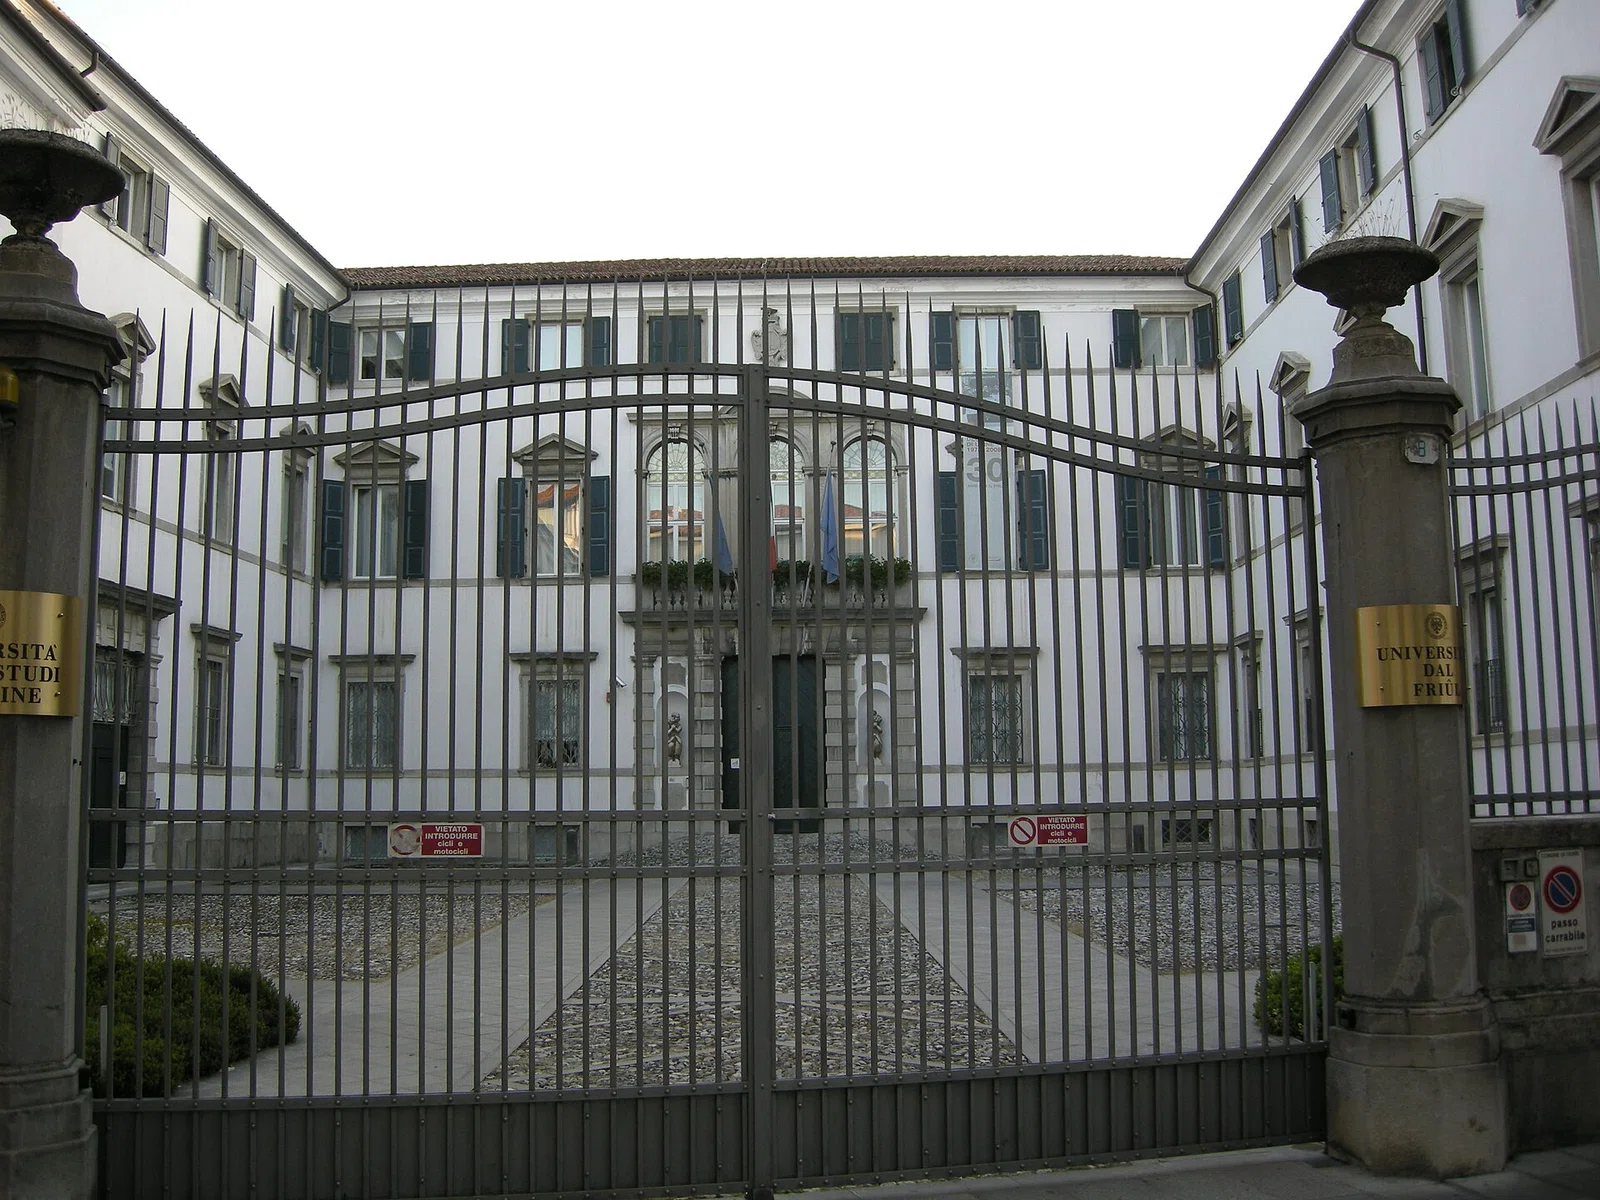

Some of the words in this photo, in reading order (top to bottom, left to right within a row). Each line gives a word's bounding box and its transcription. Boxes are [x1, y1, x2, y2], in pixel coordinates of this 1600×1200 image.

[966, 457, 1003, 482] 30
[1423, 663, 1453, 677] DAL
[1551, 919, 1578, 930] passo
[1545, 930, 1585, 943] carrabile
